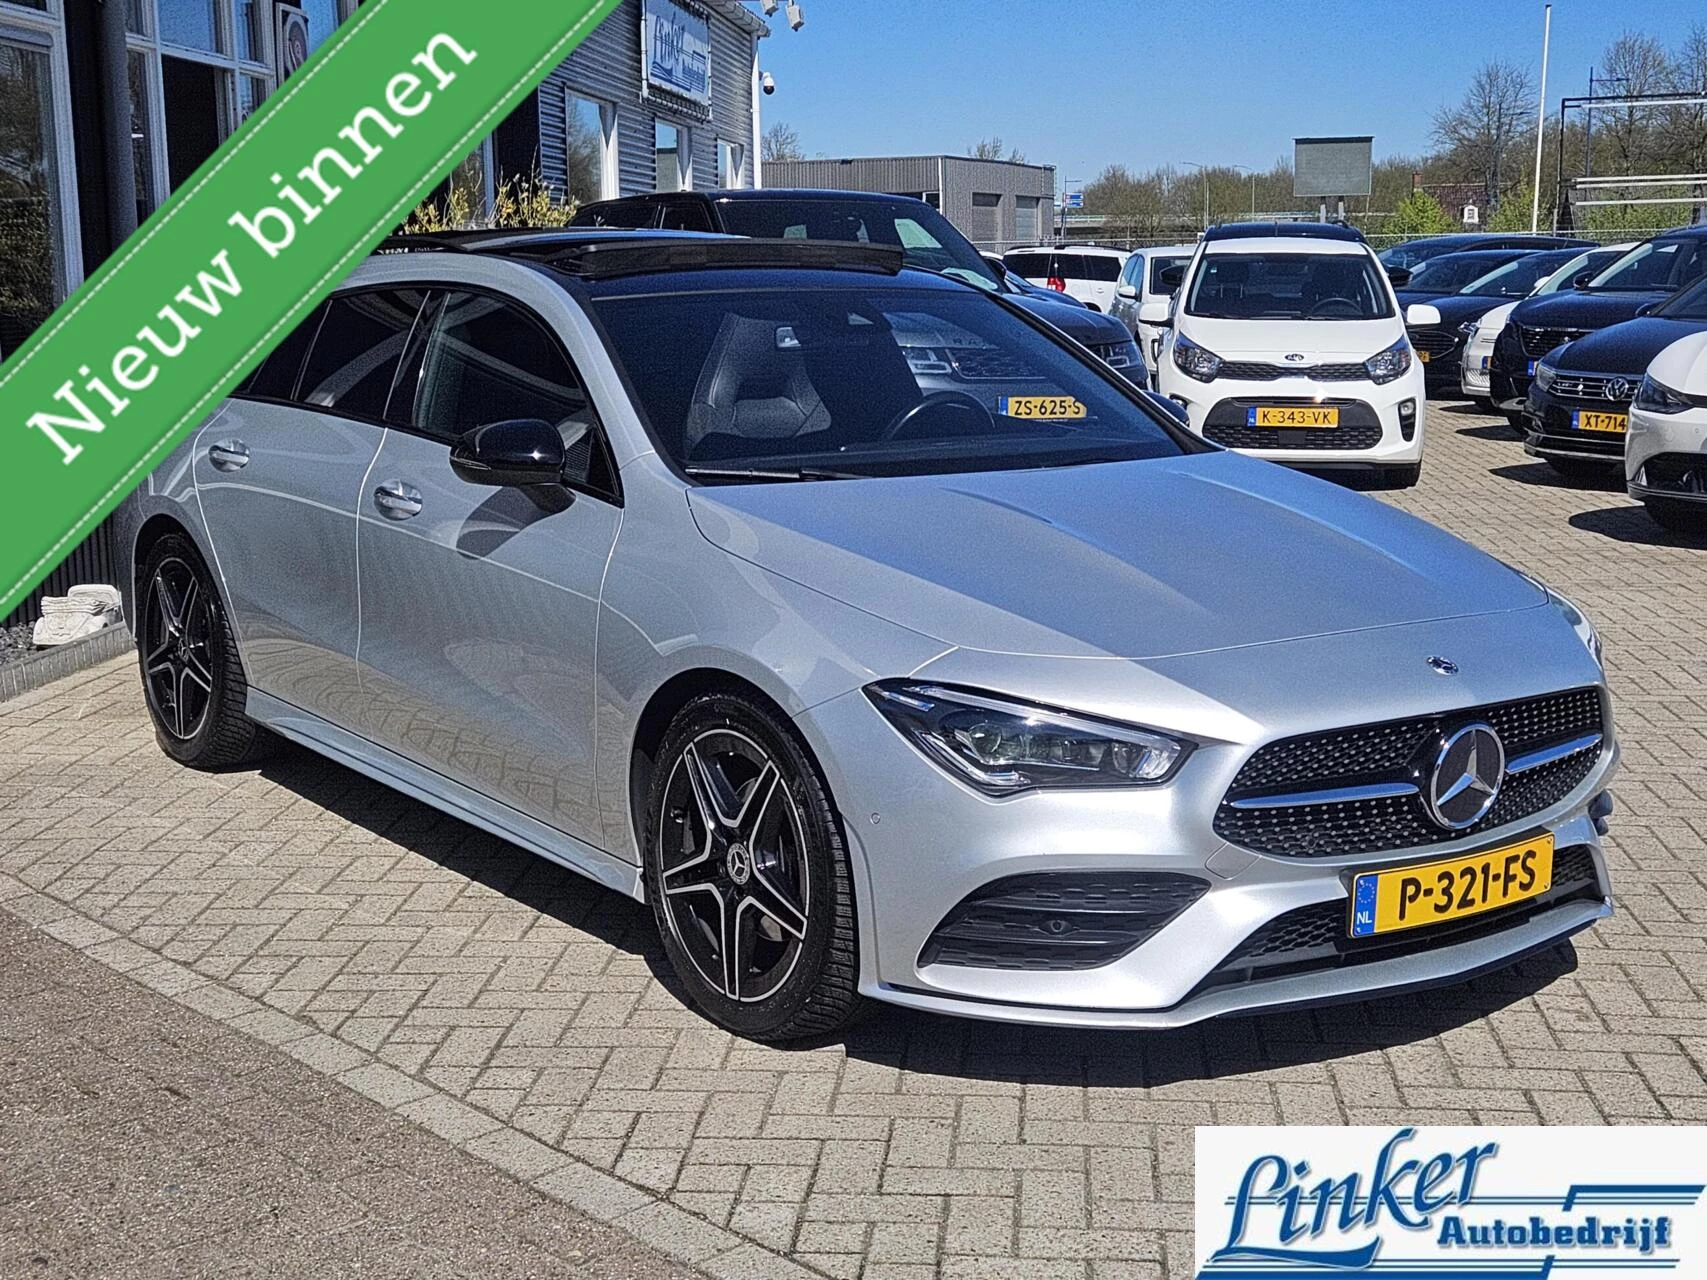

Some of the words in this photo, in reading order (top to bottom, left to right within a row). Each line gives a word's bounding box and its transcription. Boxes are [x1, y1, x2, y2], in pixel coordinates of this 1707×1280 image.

[1014, 399, 1080, 416] ZS-625-S
[1262, 410, 1331, 424] K-343-VK
[1356, 910, 1373, 925] NL
[1398, 849, 1537, 921] P-321-FS
